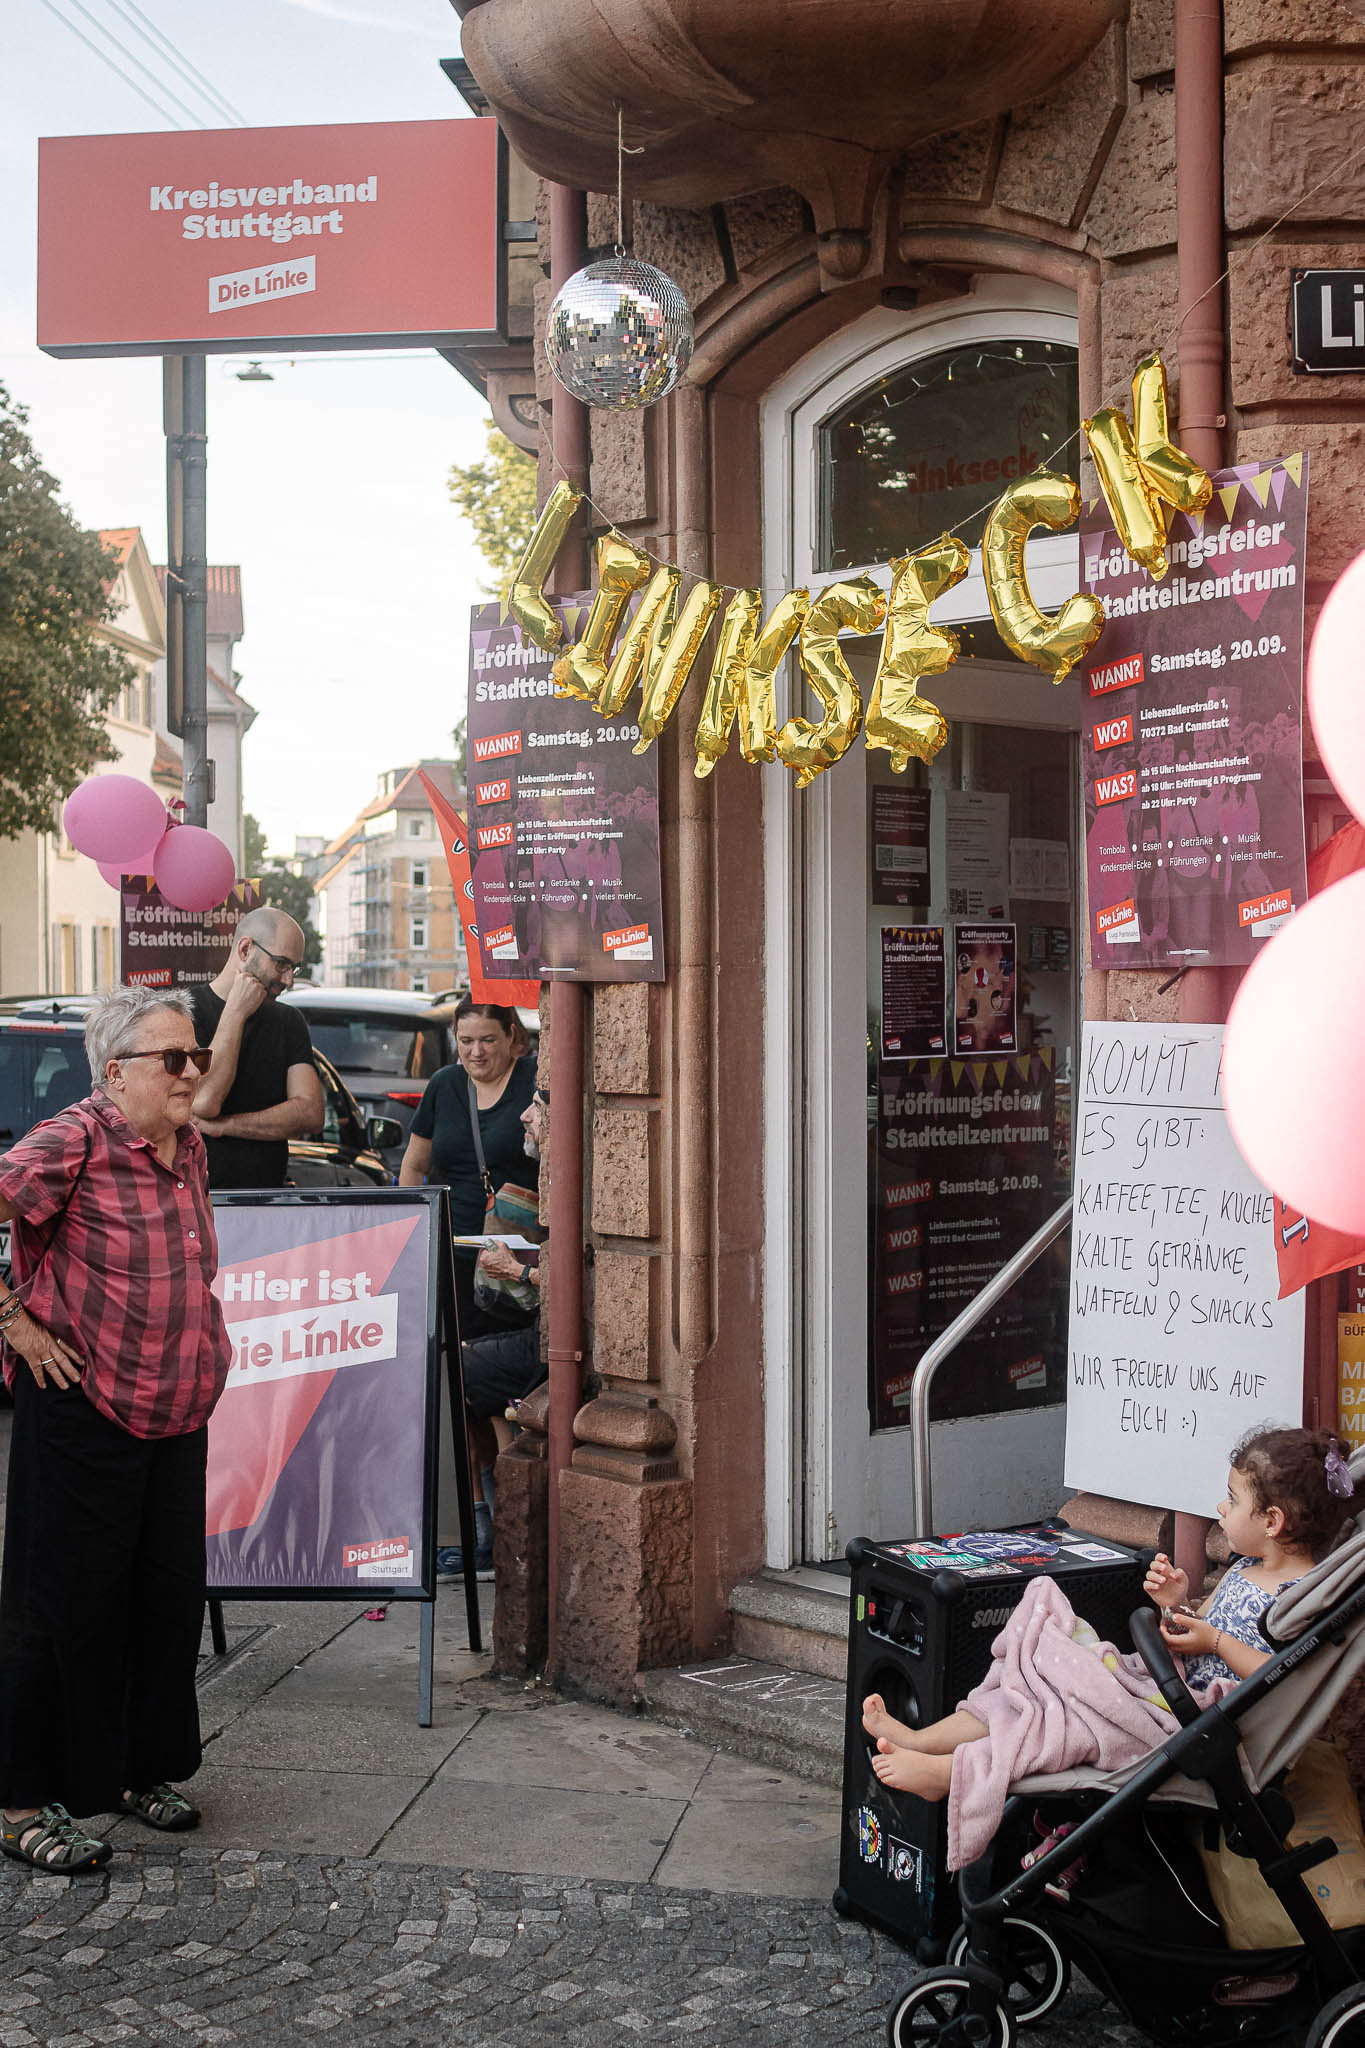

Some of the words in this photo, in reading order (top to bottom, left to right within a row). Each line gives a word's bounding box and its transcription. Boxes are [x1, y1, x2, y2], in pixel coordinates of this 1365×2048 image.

[150, 176, 377, 211] Kreisverband
[182, 209, 344, 243] Stuttgart
[218, 281, 250, 303] Die
[255, 269, 308, 295] Linke
[1321, 284, 1365, 348] Li
[1098, 564, 1296, 620] tadtteilzentrum
[1091, 659, 1141, 690] WANN?
[1151, 644, 1226, 673] Samstag,
[1230, 635, 1286, 660] 20.09.
[1140, 699, 1219, 721] Liebenzellerstraße
[1221, 698, 1228, 711] 1,
[1097, 720, 1128, 745] WO?
[1141, 727, 1166, 739] 70372
[1168, 723, 1183, 735] Bad
[1185, 717, 1229, 733] Cannstatt
[476, 736, 520, 757] WANN?
[528, 729, 593, 748] Samstag,
[1141, 769, 1149, 777] ab
[1160, 765, 1174, 775] Uhr:
[1175, 756, 1250, 772] Nachbarschaftsfest
[517, 773, 587, 784] Liebenzellerstraße
[1097, 775, 1135, 800] WAS?
[1141, 785, 1149, 793] ab
[1160, 782, 1174, 791] Uhr:
[1176, 777, 1212, 789] Eröffnung
[1213, 776, 1219, 785] &
[1220, 772, 1261, 785] Programm
[479, 782, 507, 800] WO?
[517, 788, 540, 798] 70372
[541, 788, 555, 797] Bad
[557, 786, 595, 797] Cannstatt
[1141, 802, 1150, 810] ab
[1151, 800, 1160, 808] 22
[1161, 799, 1175, 807] Uhr:
[1177, 796, 1197, 807] Party
[479, 826, 511, 846] WAS?
[547, 831, 579, 841] Eröffnung
[581, 831, 586, 839] &
[587, 830, 623, 840] Programm
[1099, 846, 1126, 855] Tombola
[1143, 843, 1162, 851] Essen
[1180, 836, 1213, 847] Getränke
[1238, 833, 1261, 844] Musik
[547, 847, 566, 855] Party
[1100, 861, 1152, 873] Kinderspiel-Ecke
[1169, 856, 1207, 867] Führungen
[1230, 852, 1252, 862] vieles
[482, 881, 505, 889] Tombola
[551, 879, 580, 887] Getränke
[602, 879, 623, 887] Musik
[541, 894, 575, 903] Führungen
[596, 893, 615, 901] vieles
[1243, 905, 1259, 920] Die
[1261, 898, 1287, 915] Linke
[125, 906, 246, 928] Eröffnungsfei
[1099, 914, 1112, 928] Die
[128, 931, 234, 947] Stadtteilzent
[486, 936, 496, 947] Die
[606, 935, 621, 947] Die
[622, 930, 645, 943] Linke
[129, 972, 170, 984] WANN?
[177, 971, 219, 981] Samsta
[1086, 1035, 1199, 1096] KOMMT
[883, 1089, 1042, 1119] Eröffnungsfeier
[886, 1124, 1049, 1149] Stadtteilzentrum
[1082, 1112, 1115, 1155] ES
[887, 1184, 931, 1203] WANN?
[939, 1178, 999, 1195] Samstag,
[1002, 1175, 1042, 1190] 20.09.
[1220, 1190, 1274, 1225] KUCHE
[890, 1229, 918, 1247] WO?
[1076, 1230, 1134, 1270] KALTE
[224, 1270, 309, 1302] Hier
[319, 1269, 371, 1300] ist
[888, 1272, 923, 1292] WAS?
[1076, 1280, 1157, 1317] WAFFELN
[1191, 1294, 1273, 1328] SNACKS
[282, 1316, 383, 1363] Linke
[1073, 1351, 1105, 1389] WIR
[1112, 1358, 1178, 1389] FREUEN
[1190, 1365, 1218, 1391] UNS
[1230, 1370, 1267, 1399] AUF
[1121, 1399, 1167, 1434] EUCH
[347, 1549, 369, 1563] Die
[371, 1542, 405, 1559] Linke
[371, 1565, 408, 1575] Stuttgart
[971, 1607, 1015, 1628] SOUN
